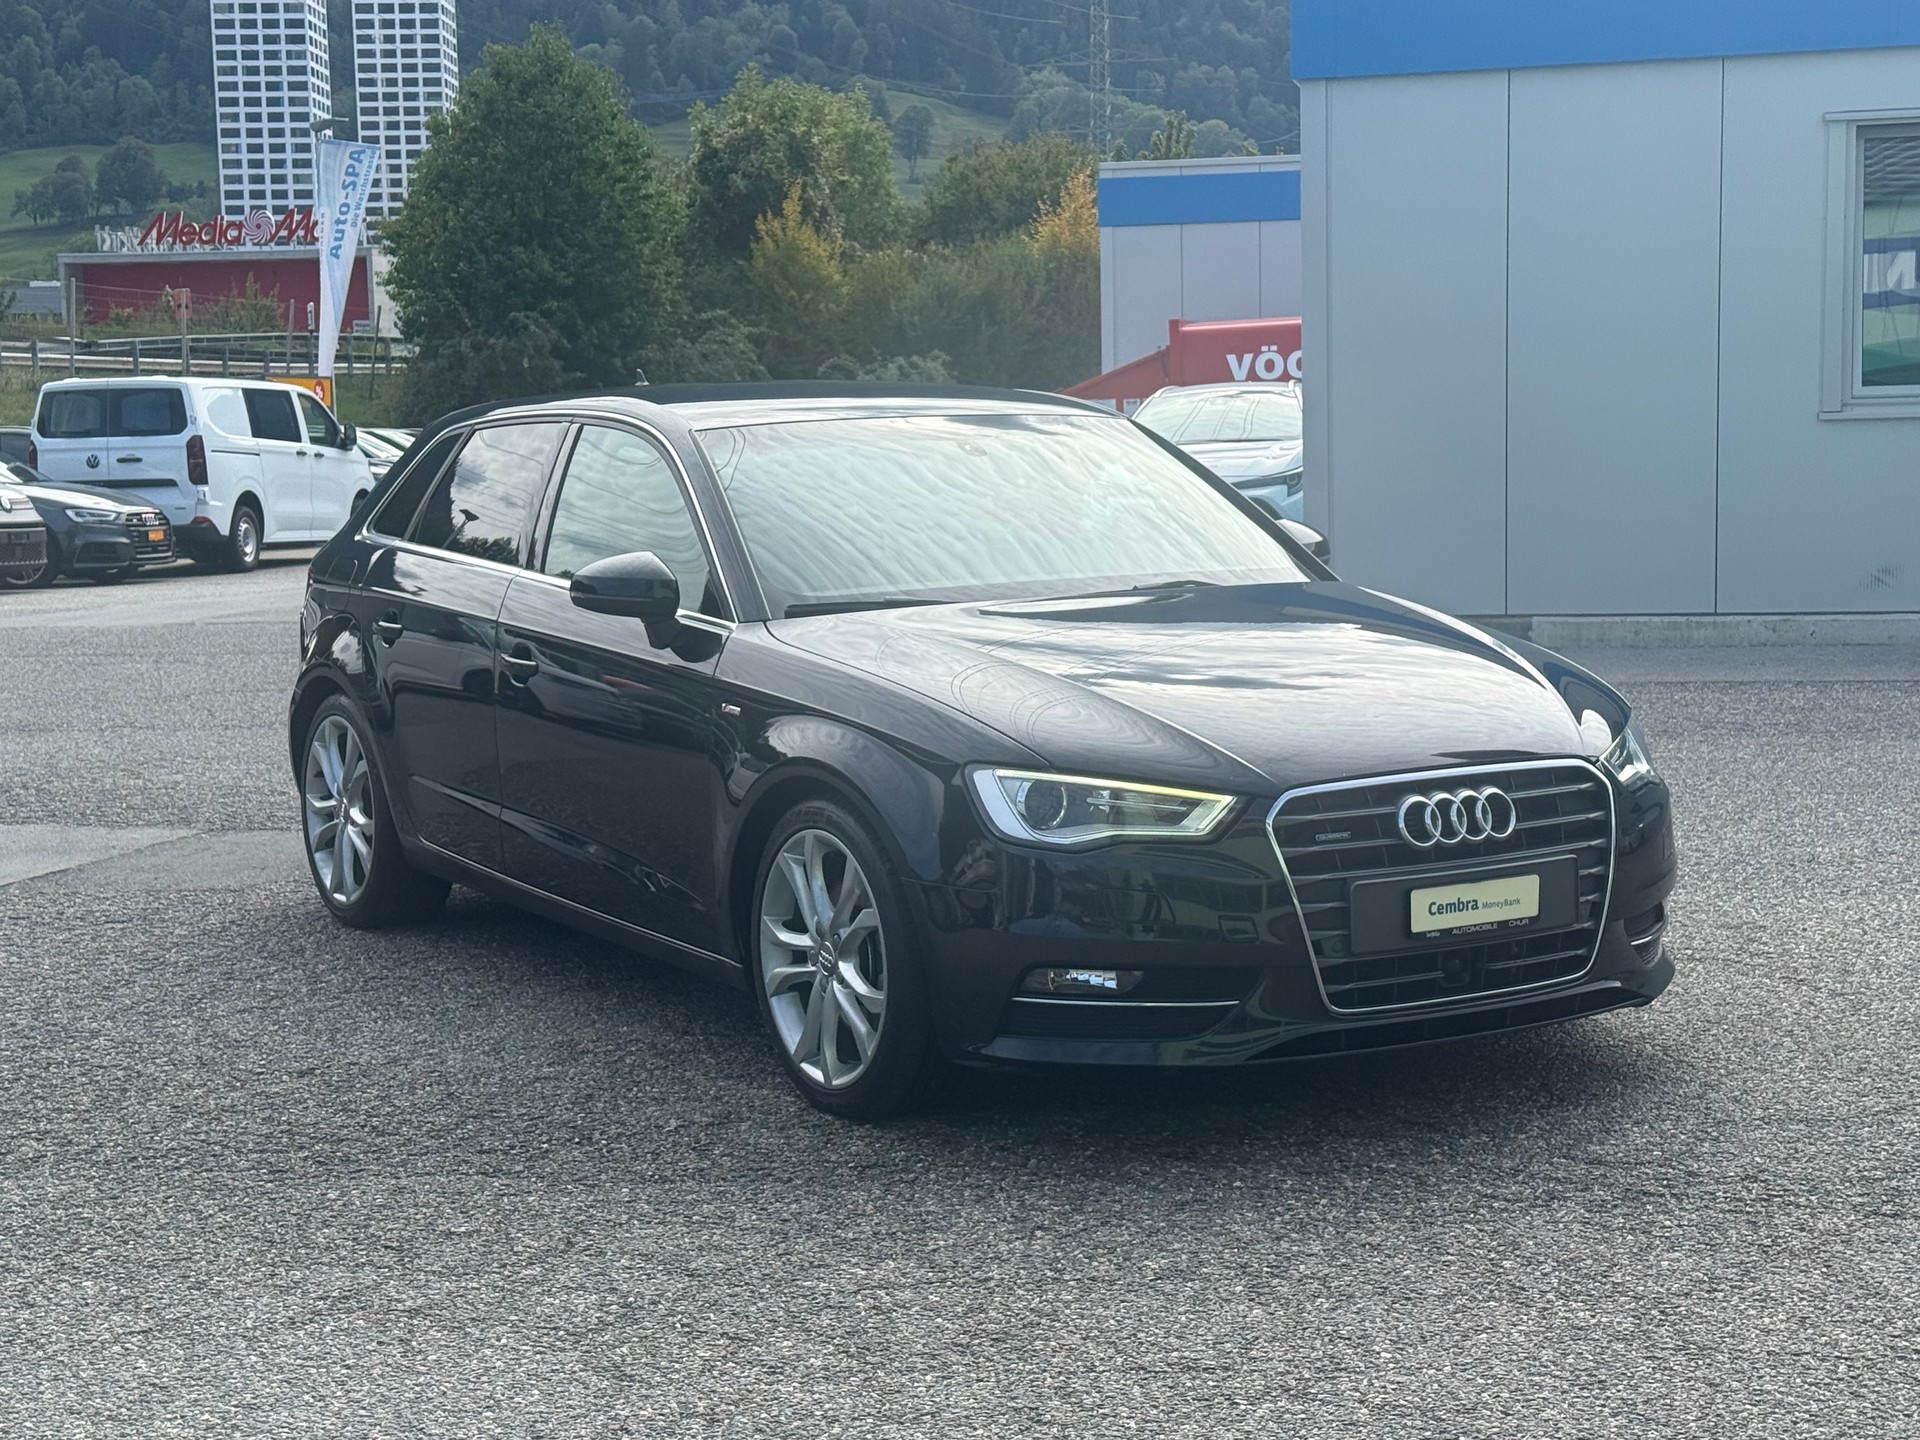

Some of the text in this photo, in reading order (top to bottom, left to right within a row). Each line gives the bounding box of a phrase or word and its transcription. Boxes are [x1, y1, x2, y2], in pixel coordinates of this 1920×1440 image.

[330, 148, 366, 260] Auto-SPA
[137, 210, 243, 246] Media
[350, 213, 360, 228] Die
[1428, 897, 1521, 916] Cembra MoneyBank
[1452, 922, 1498, 935] AUTOMOBILE
[1508, 918, 1529, 927] CHUR
